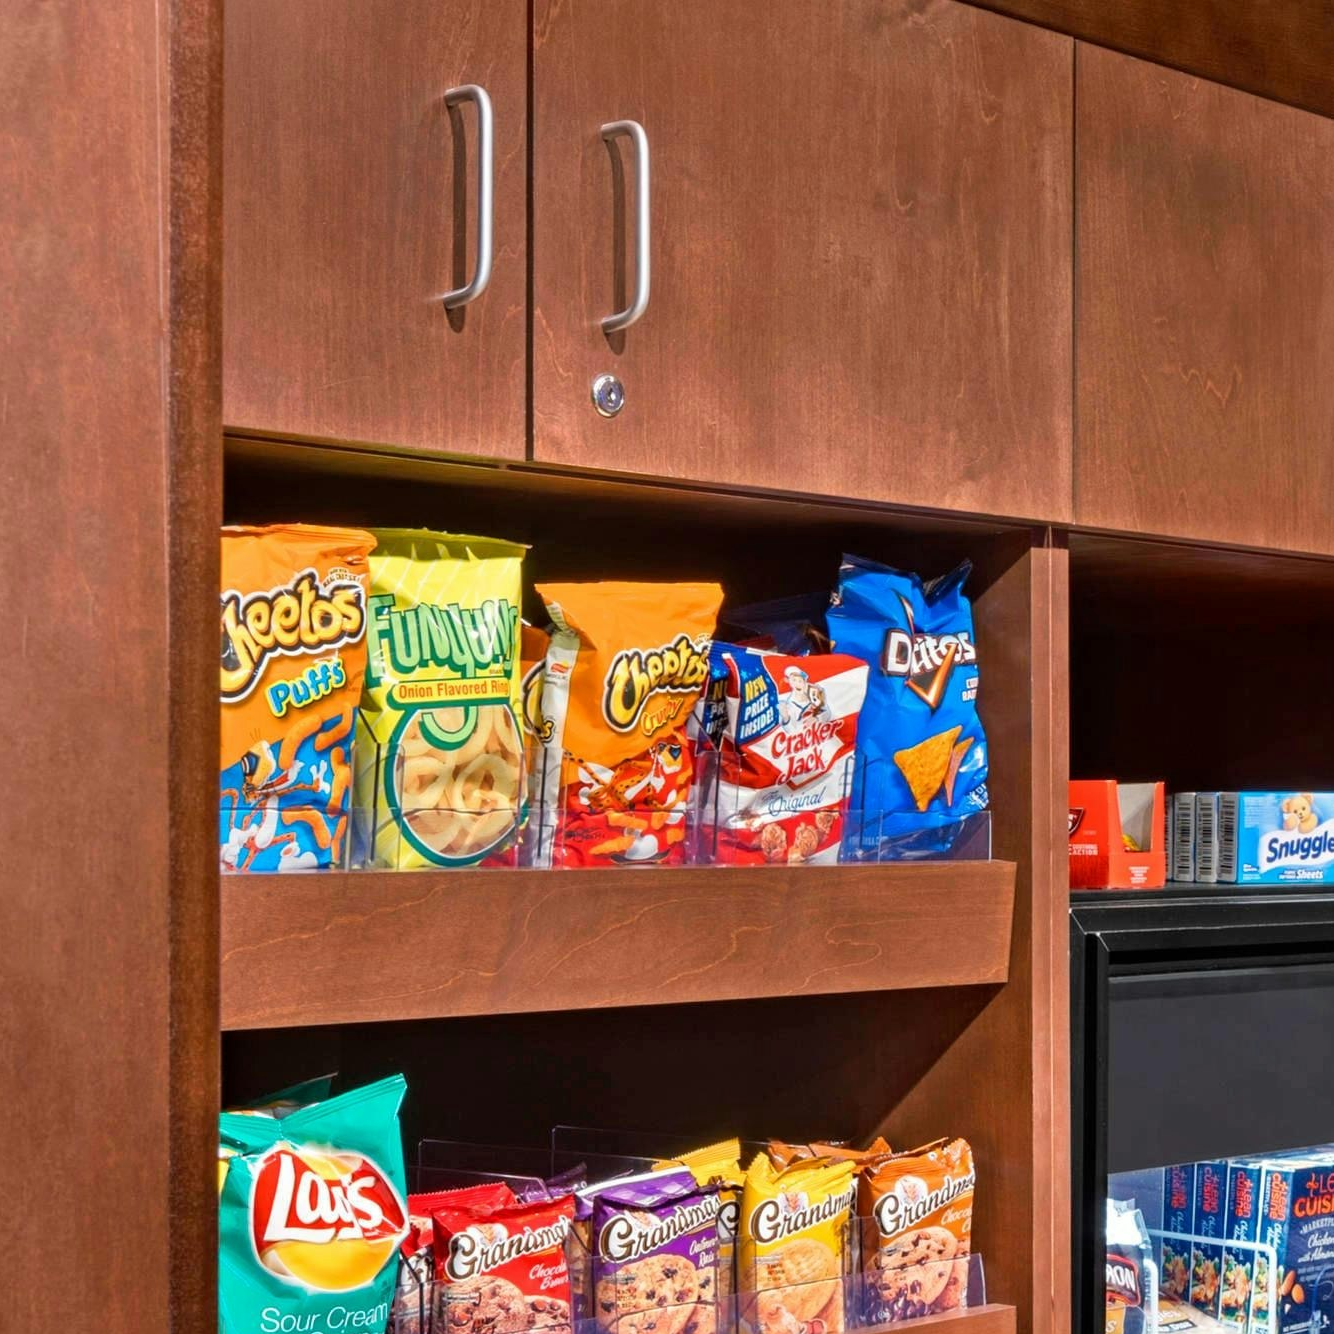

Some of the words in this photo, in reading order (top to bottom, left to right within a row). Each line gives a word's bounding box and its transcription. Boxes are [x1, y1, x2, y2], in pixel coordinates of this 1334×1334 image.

[220, 573, 364, 696] heetos
[268, 660, 345, 714] Puffs
[399, 684, 433, 699] Onion
[437, 681, 488, 697] Flavored
[744, 675, 768, 703] NEW
[744, 693, 770, 721] PRIZE
[740, 707, 774, 739] INSIDE!
[771, 719, 844, 759] Cracker
[777, 748, 826, 786] Jack
[768, 786, 827, 815] Original
[1296, 869, 1324, 880] Sheets
[260, 1306, 320, 1333] Sour
[326, 1302, 388, 1329] Cream
